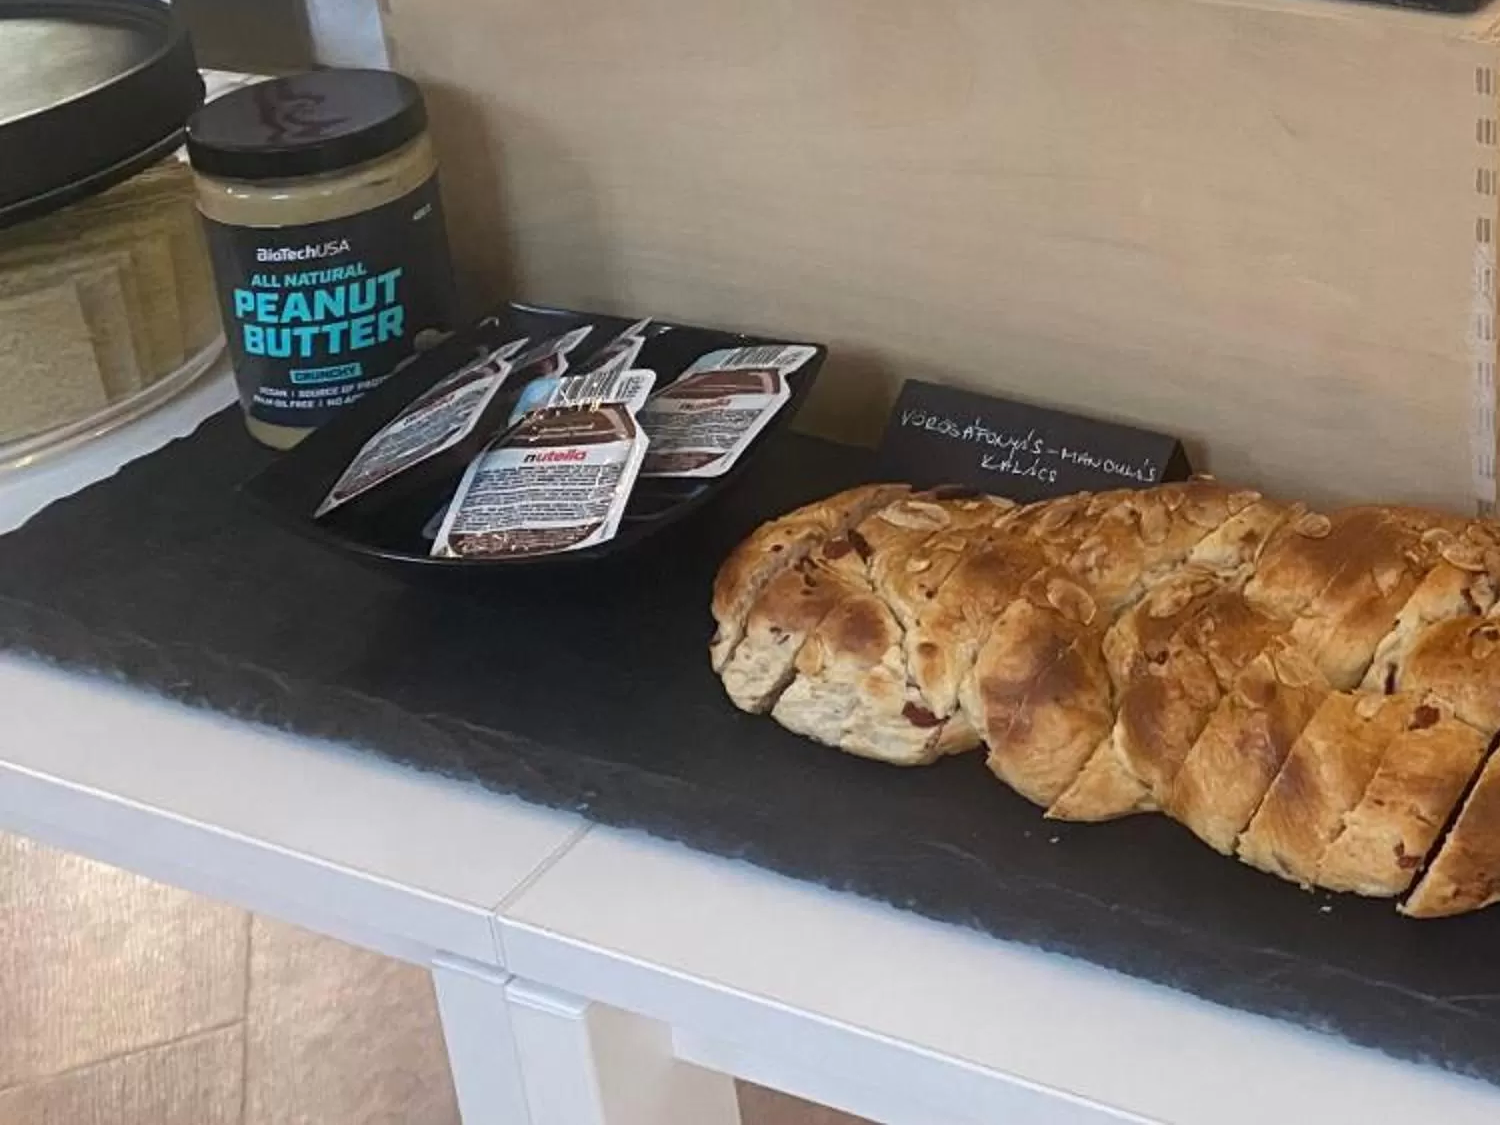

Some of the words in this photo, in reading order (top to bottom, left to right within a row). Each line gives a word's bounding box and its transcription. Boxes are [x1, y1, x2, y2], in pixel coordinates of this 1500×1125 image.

[256, 239, 351, 262] BioTechUSA
[251, 274, 282, 288] ALL
[284, 262, 368, 288] NATURAL
[233, 267, 404, 324] PEANUT
[243, 305, 405, 358] BUTTER
[523, 448, 588, 464] nutella
